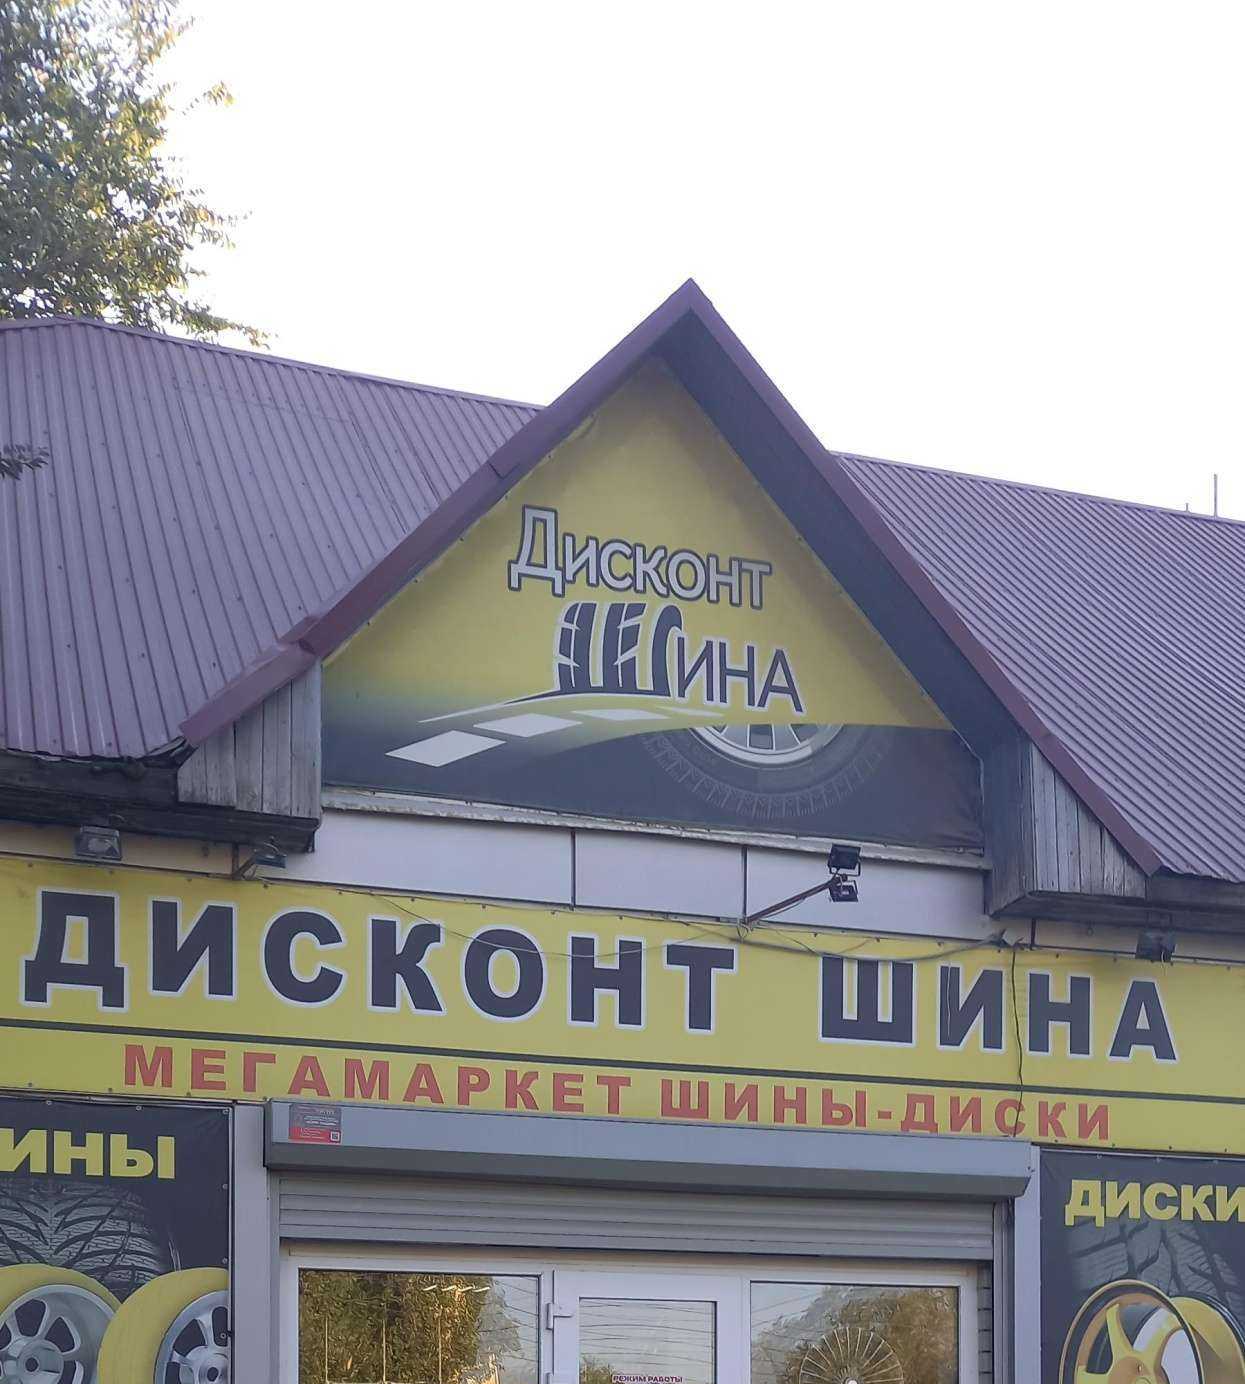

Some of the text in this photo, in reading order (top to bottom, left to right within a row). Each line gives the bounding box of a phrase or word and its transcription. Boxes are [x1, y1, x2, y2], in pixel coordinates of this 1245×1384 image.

[22, 890, 1177, 1061] ДИСКОНТ ШИНА
[124, 1043, 1109, 1141] МЕГАМАРКЕТ ШИНЫ-ДИСКИ
[1065, 1179, 1245, 1228] ДИСКИ
[612, 1374, 683, 1384] РЕЖИМ РАБОТЫ
